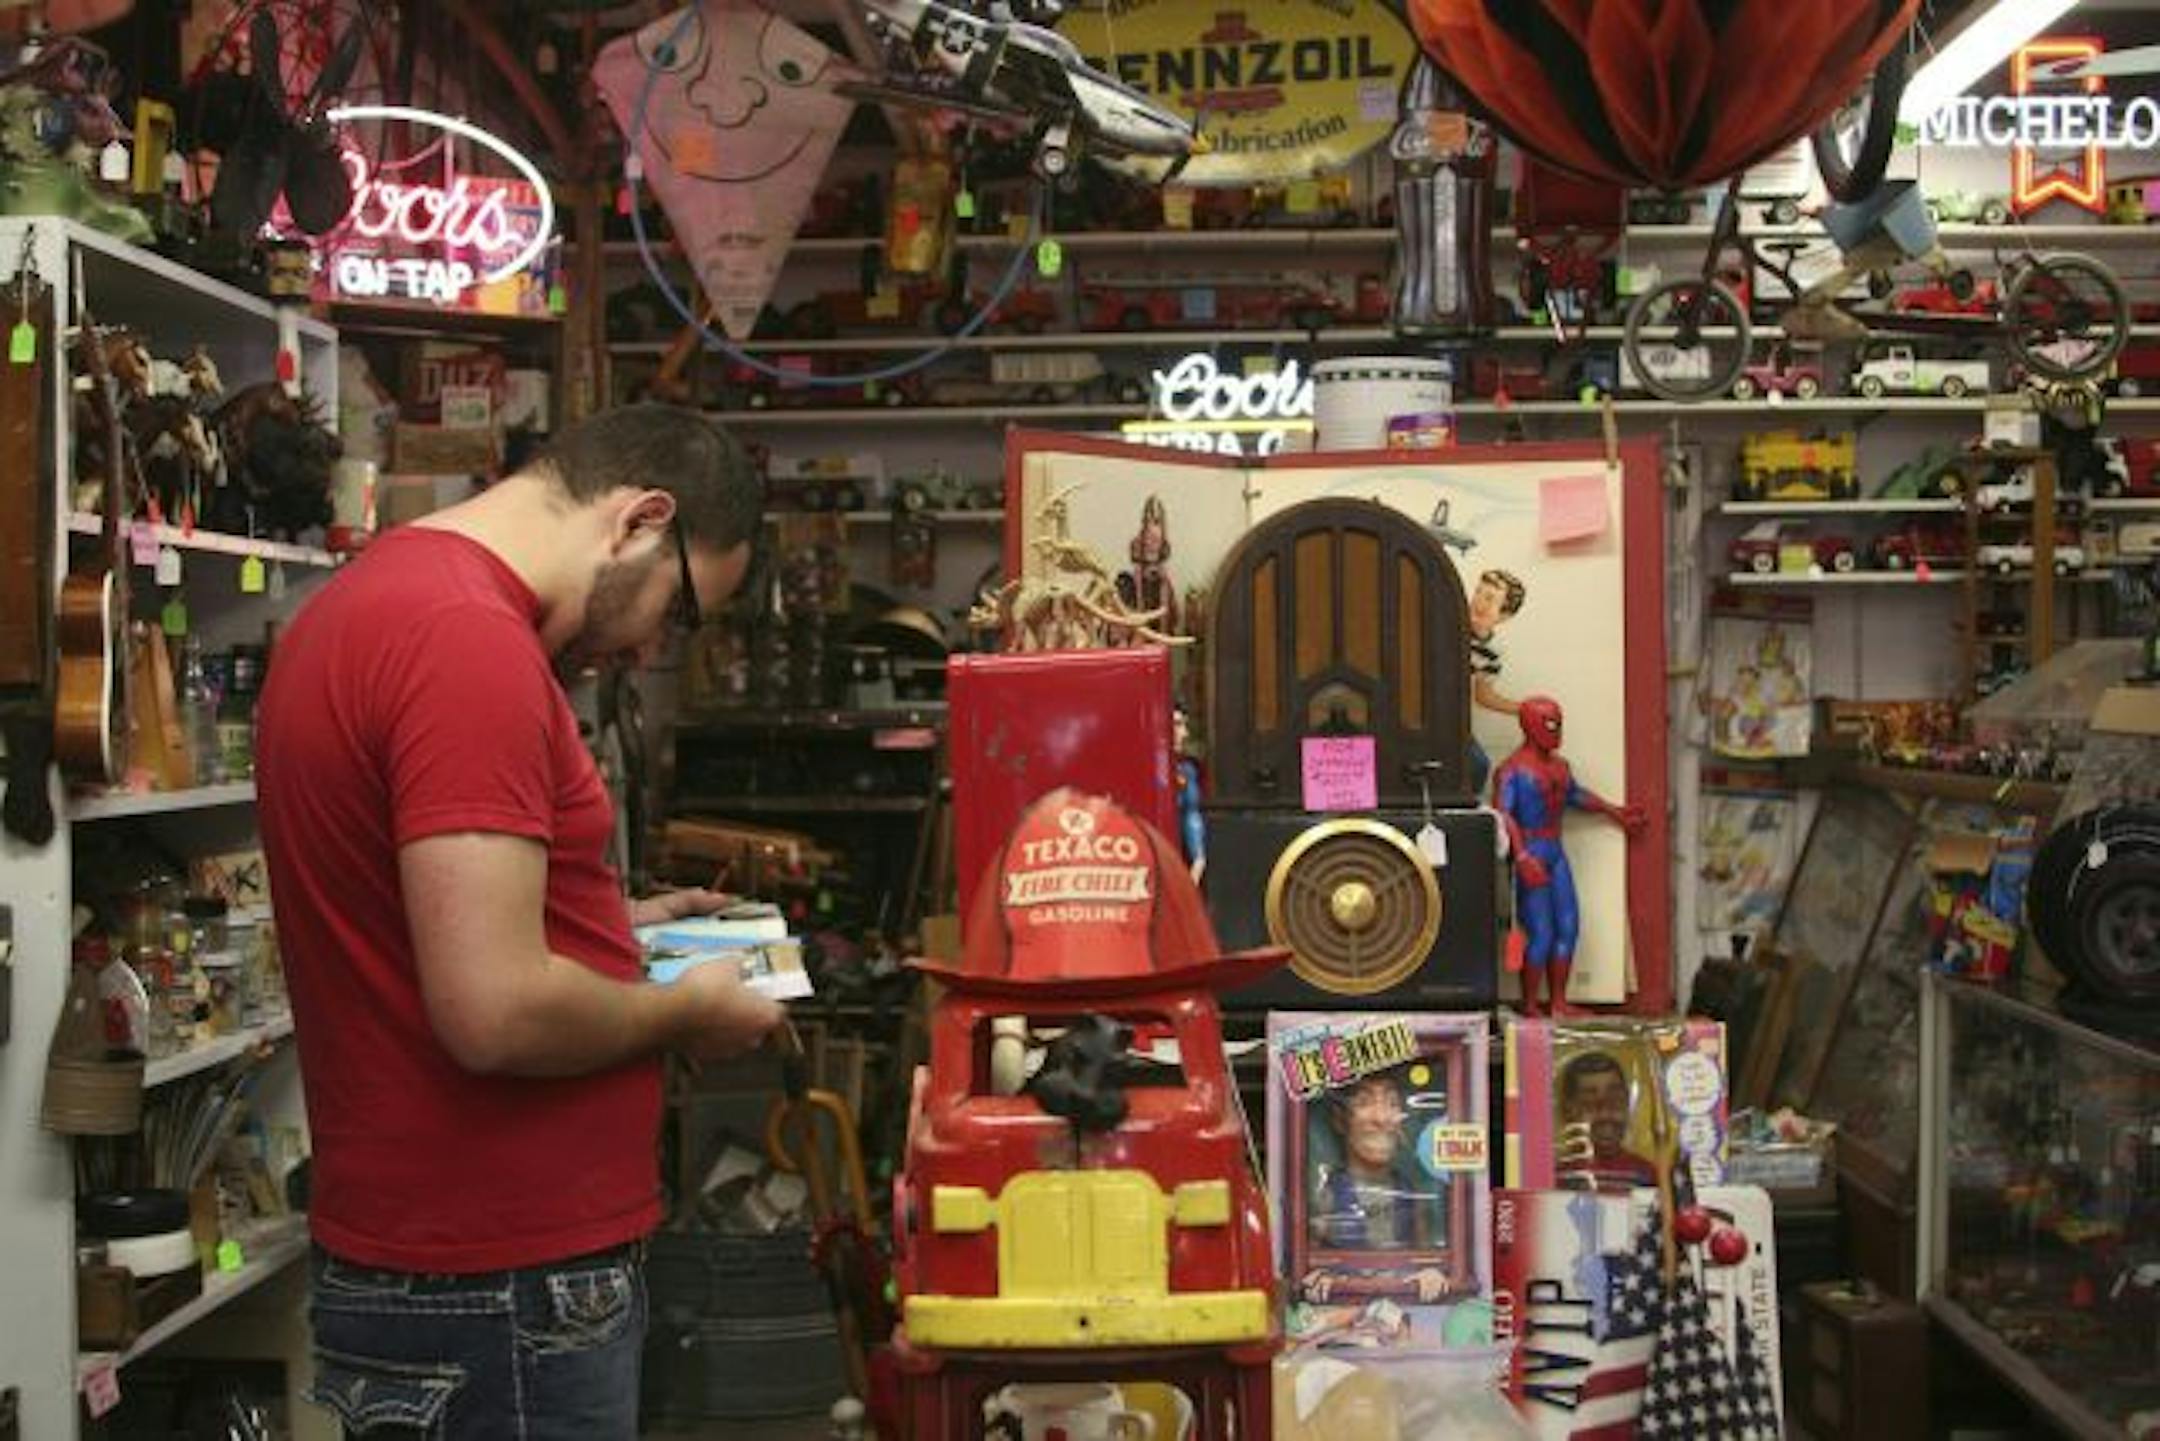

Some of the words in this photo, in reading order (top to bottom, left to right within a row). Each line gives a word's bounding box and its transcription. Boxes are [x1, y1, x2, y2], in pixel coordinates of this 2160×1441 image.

[1205, 112, 1348, 153] ubrication
[337, 254, 390, 295] ON
[399, 257, 475, 302] TAP
[1021, 834, 1139, 866] TEXACO
[1027, 903, 1129, 926] GASOLINE
